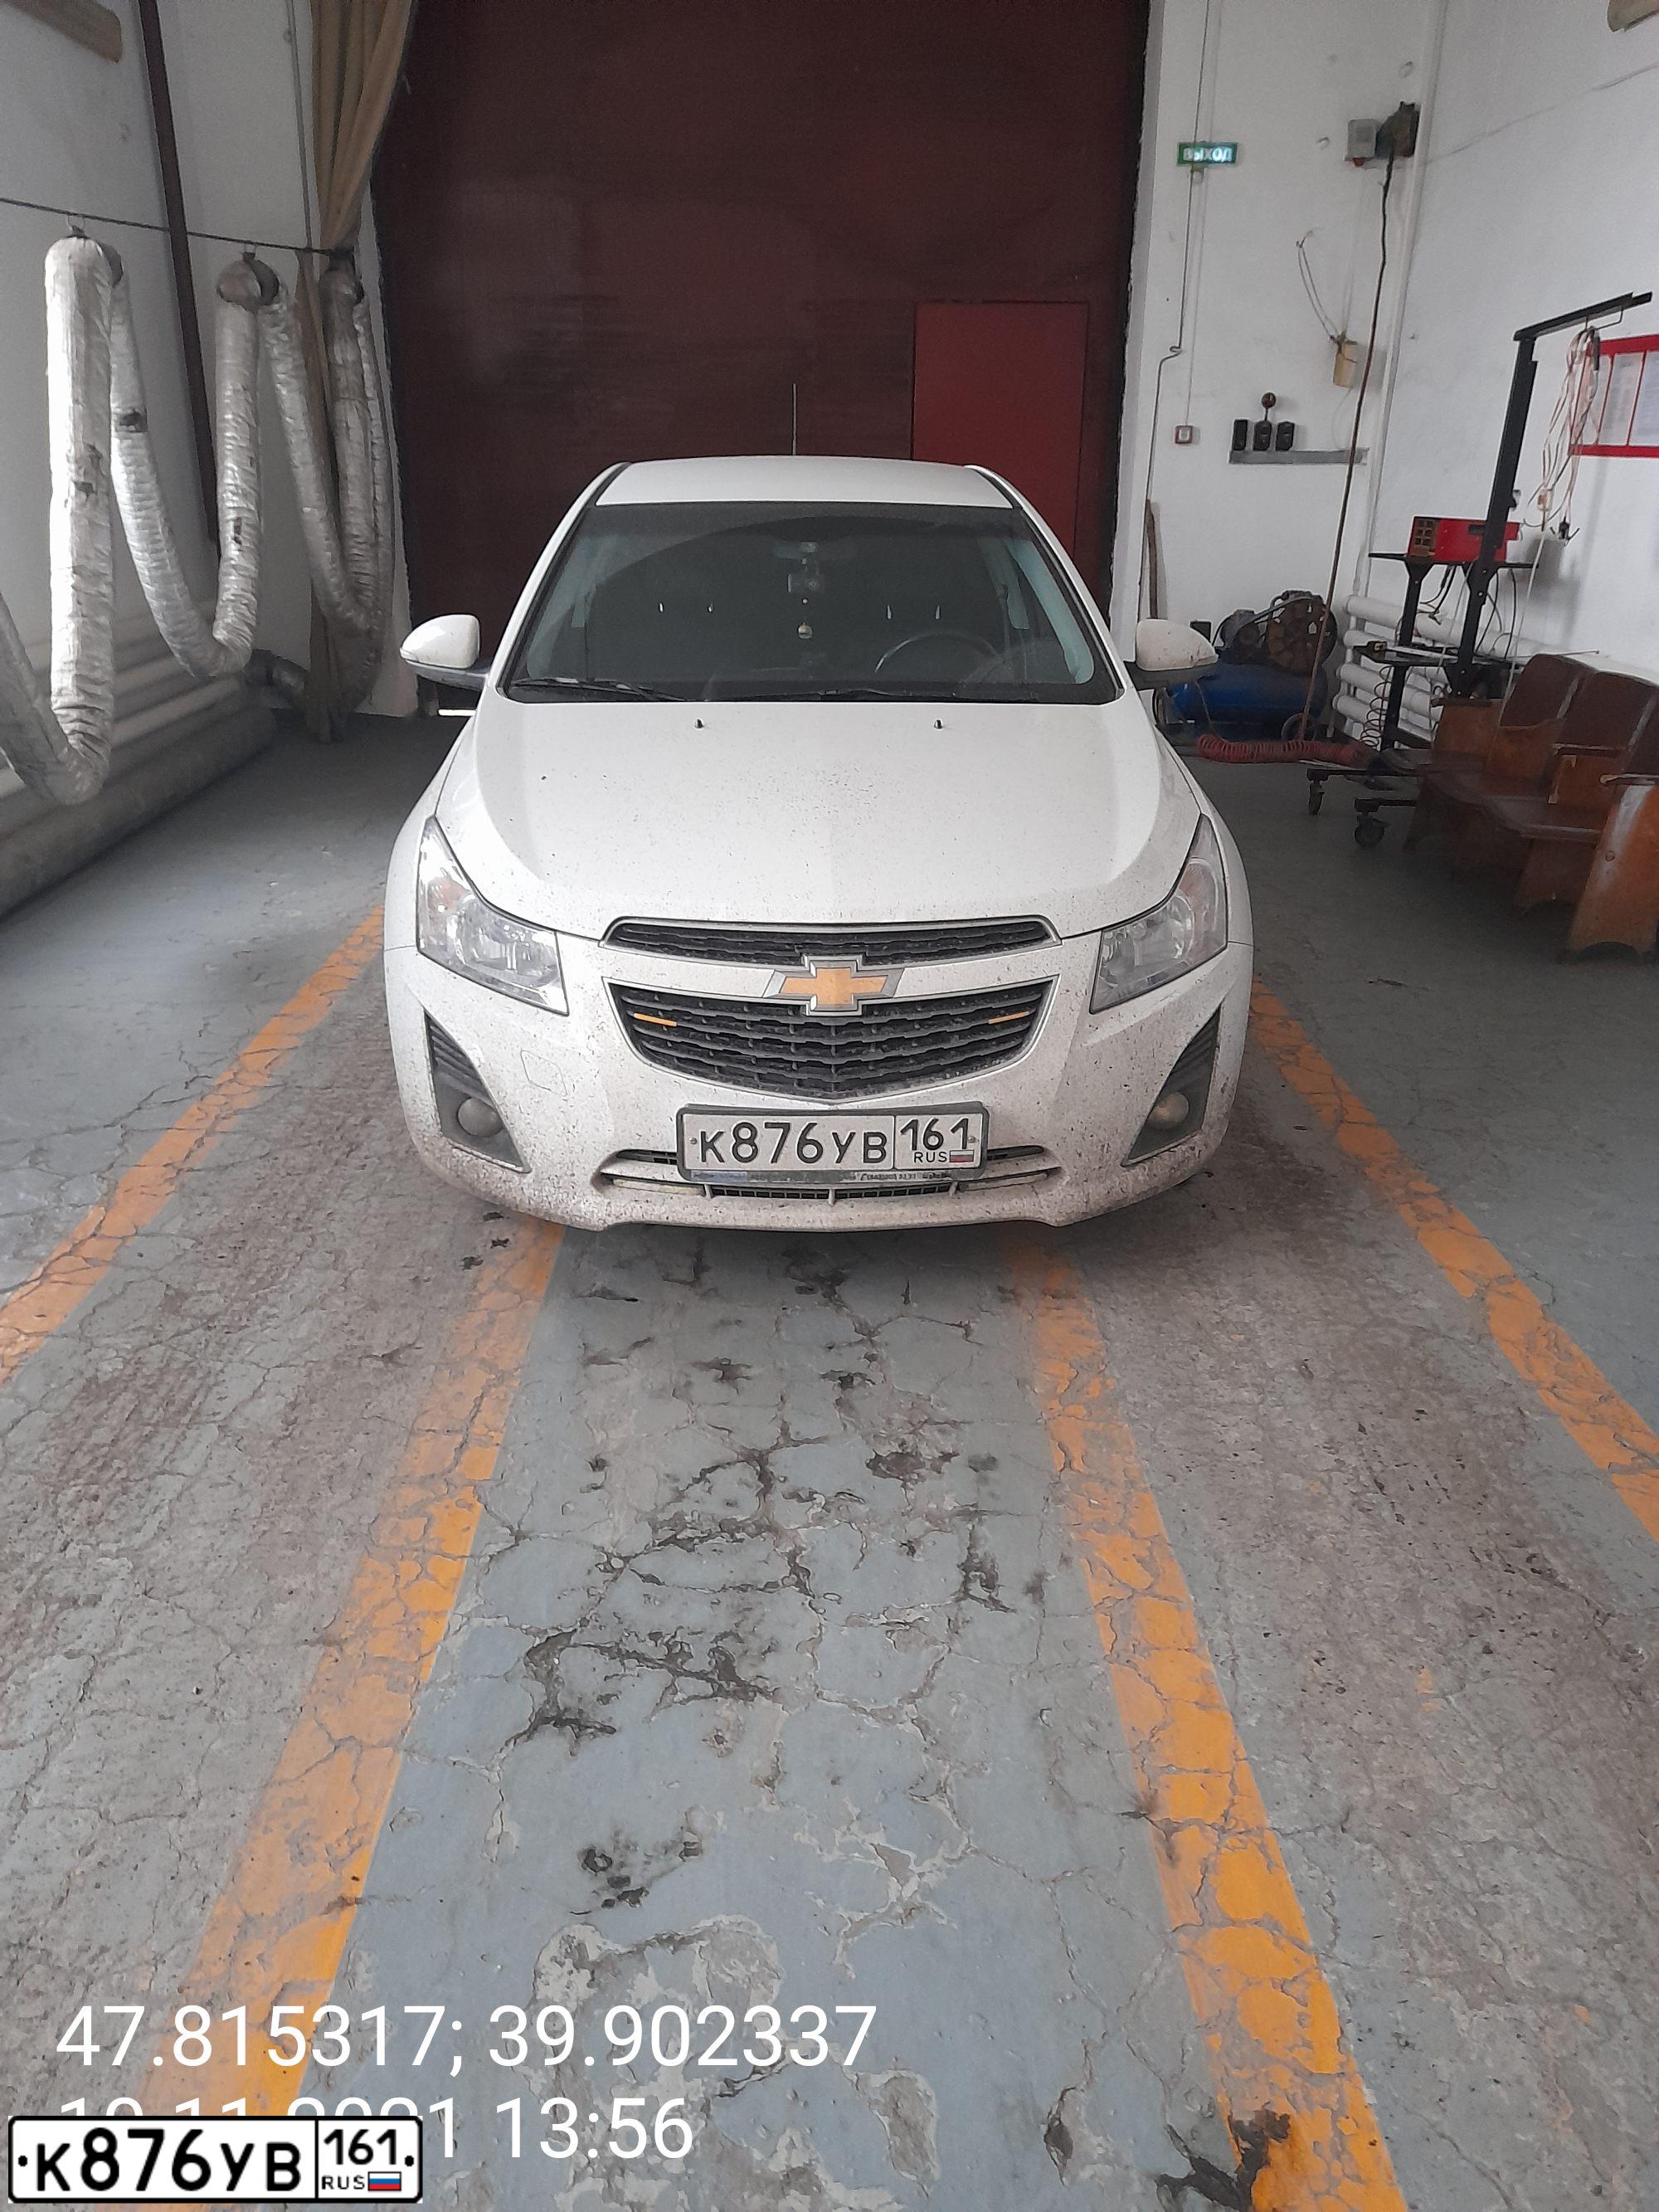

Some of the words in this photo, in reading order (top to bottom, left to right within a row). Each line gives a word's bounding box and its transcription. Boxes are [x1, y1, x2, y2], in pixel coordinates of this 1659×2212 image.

[1182, 148, 1233, 163] ВЫХОД
[900, 1118, 968, 1151] 161
[914, 1152, 947, 1163] RUS
